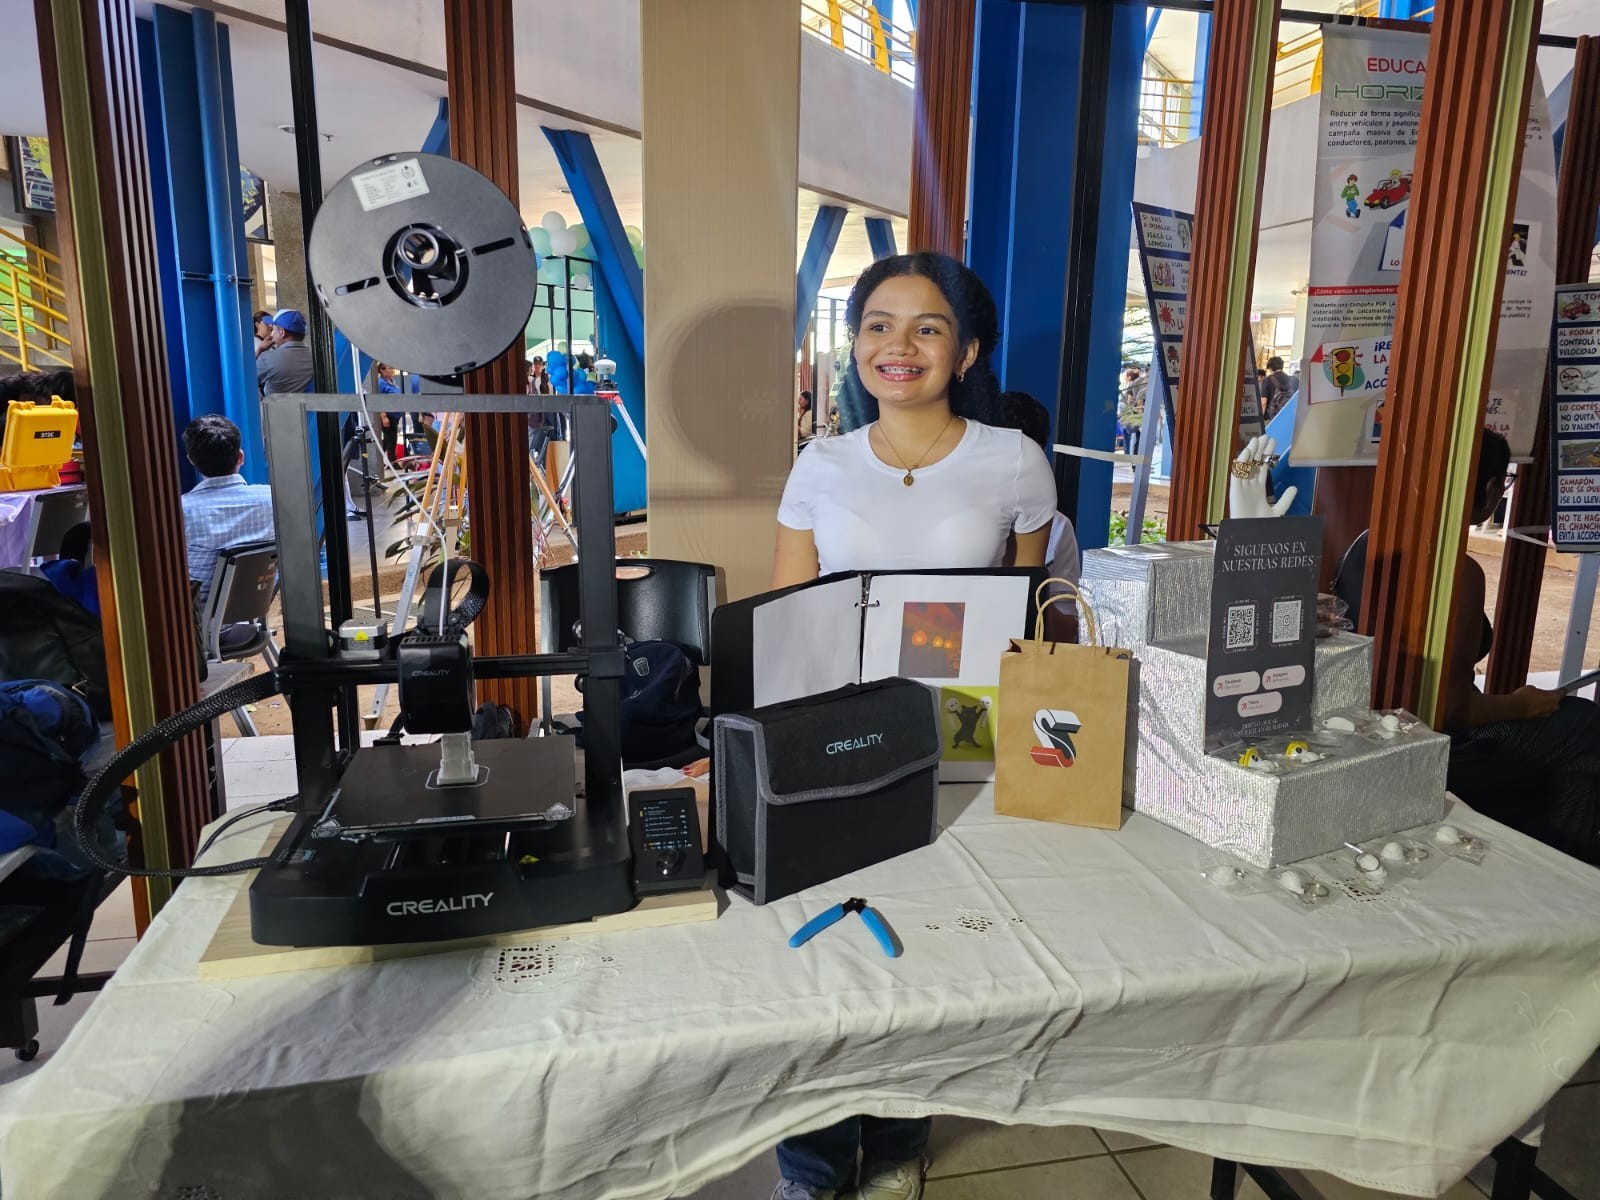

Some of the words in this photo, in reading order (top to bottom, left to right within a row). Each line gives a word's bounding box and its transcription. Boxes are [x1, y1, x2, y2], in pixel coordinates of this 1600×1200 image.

[1367, 58, 1426, 74] EDUCA
[1359, 109, 1368, 117] de
[1370, 109, 1391, 117] forma
[1350, 119, 1383, 127] vehículos
[1328, 129, 1360, 138] campaña
[1327, 138, 1373, 147] conductores,
[1559, 347, 1597, 356] VELOCIDAD
[1373, 355, 1387, 364] LA
[1560, 414, 1571, 422] NO
[1573, 413, 1595, 421] QUITA
[1559, 486, 1574, 494] QUE
[1558, 514, 1570, 522] NO
[1573, 514, 1582, 522] TE
[1558, 523, 1567, 531] EL
[1558, 531, 1575, 540] EVITA
[1233, 542, 1290, 557] SIGUENOS
[1292, 541, 1307, 554] EN
[1222, 557, 1278, 573] NUESTRAS
[1280, 554, 1315, 569] REDES
[411, 669, 450, 677] CREALITY
[826, 732, 884, 755] CREALITY
[386, 892, 494, 916] CREALITY
